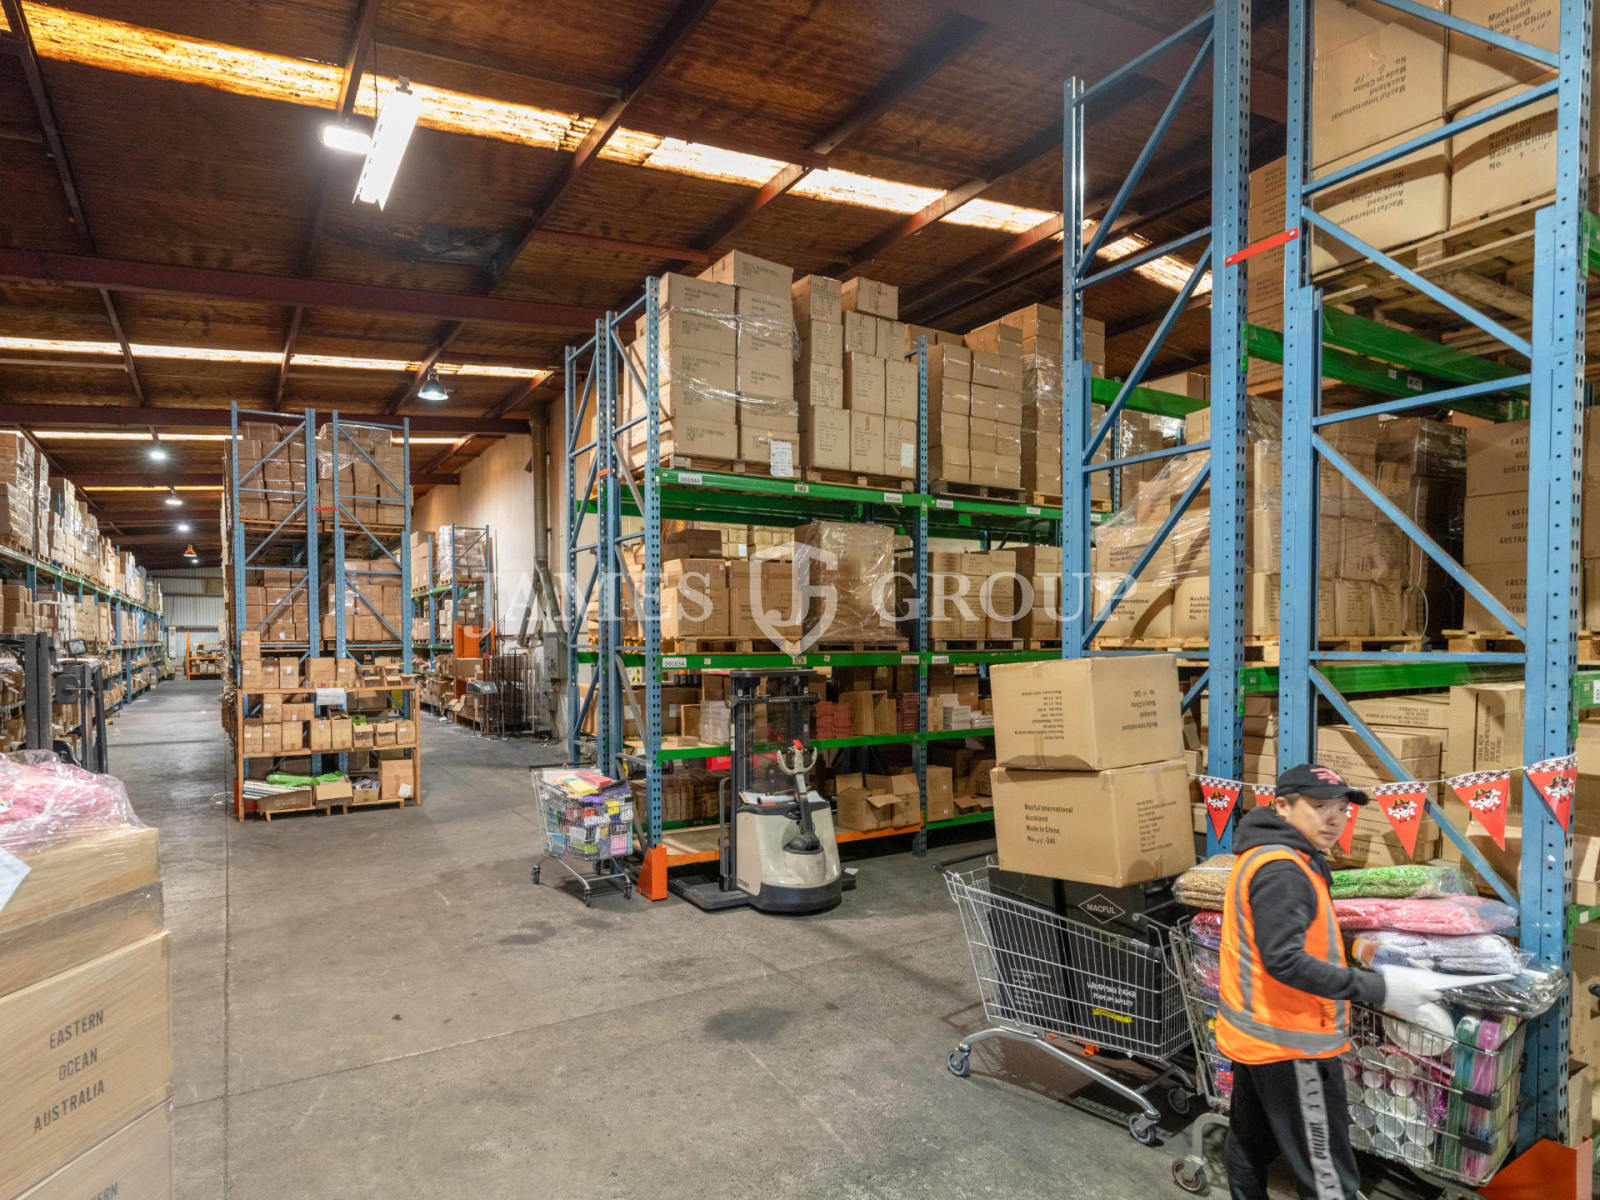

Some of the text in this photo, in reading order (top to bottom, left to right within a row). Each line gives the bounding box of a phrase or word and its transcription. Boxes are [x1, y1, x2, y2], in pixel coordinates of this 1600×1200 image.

[1524, 9, 1552, 26] China
[1086, 903, 1116, 914] MACFUL
[48, 1009, 104, 1049] EASTERN
[58, 1047, 98, 1081] OCEAN
[33, 1079, 105, 1133] AUSTRALIA
